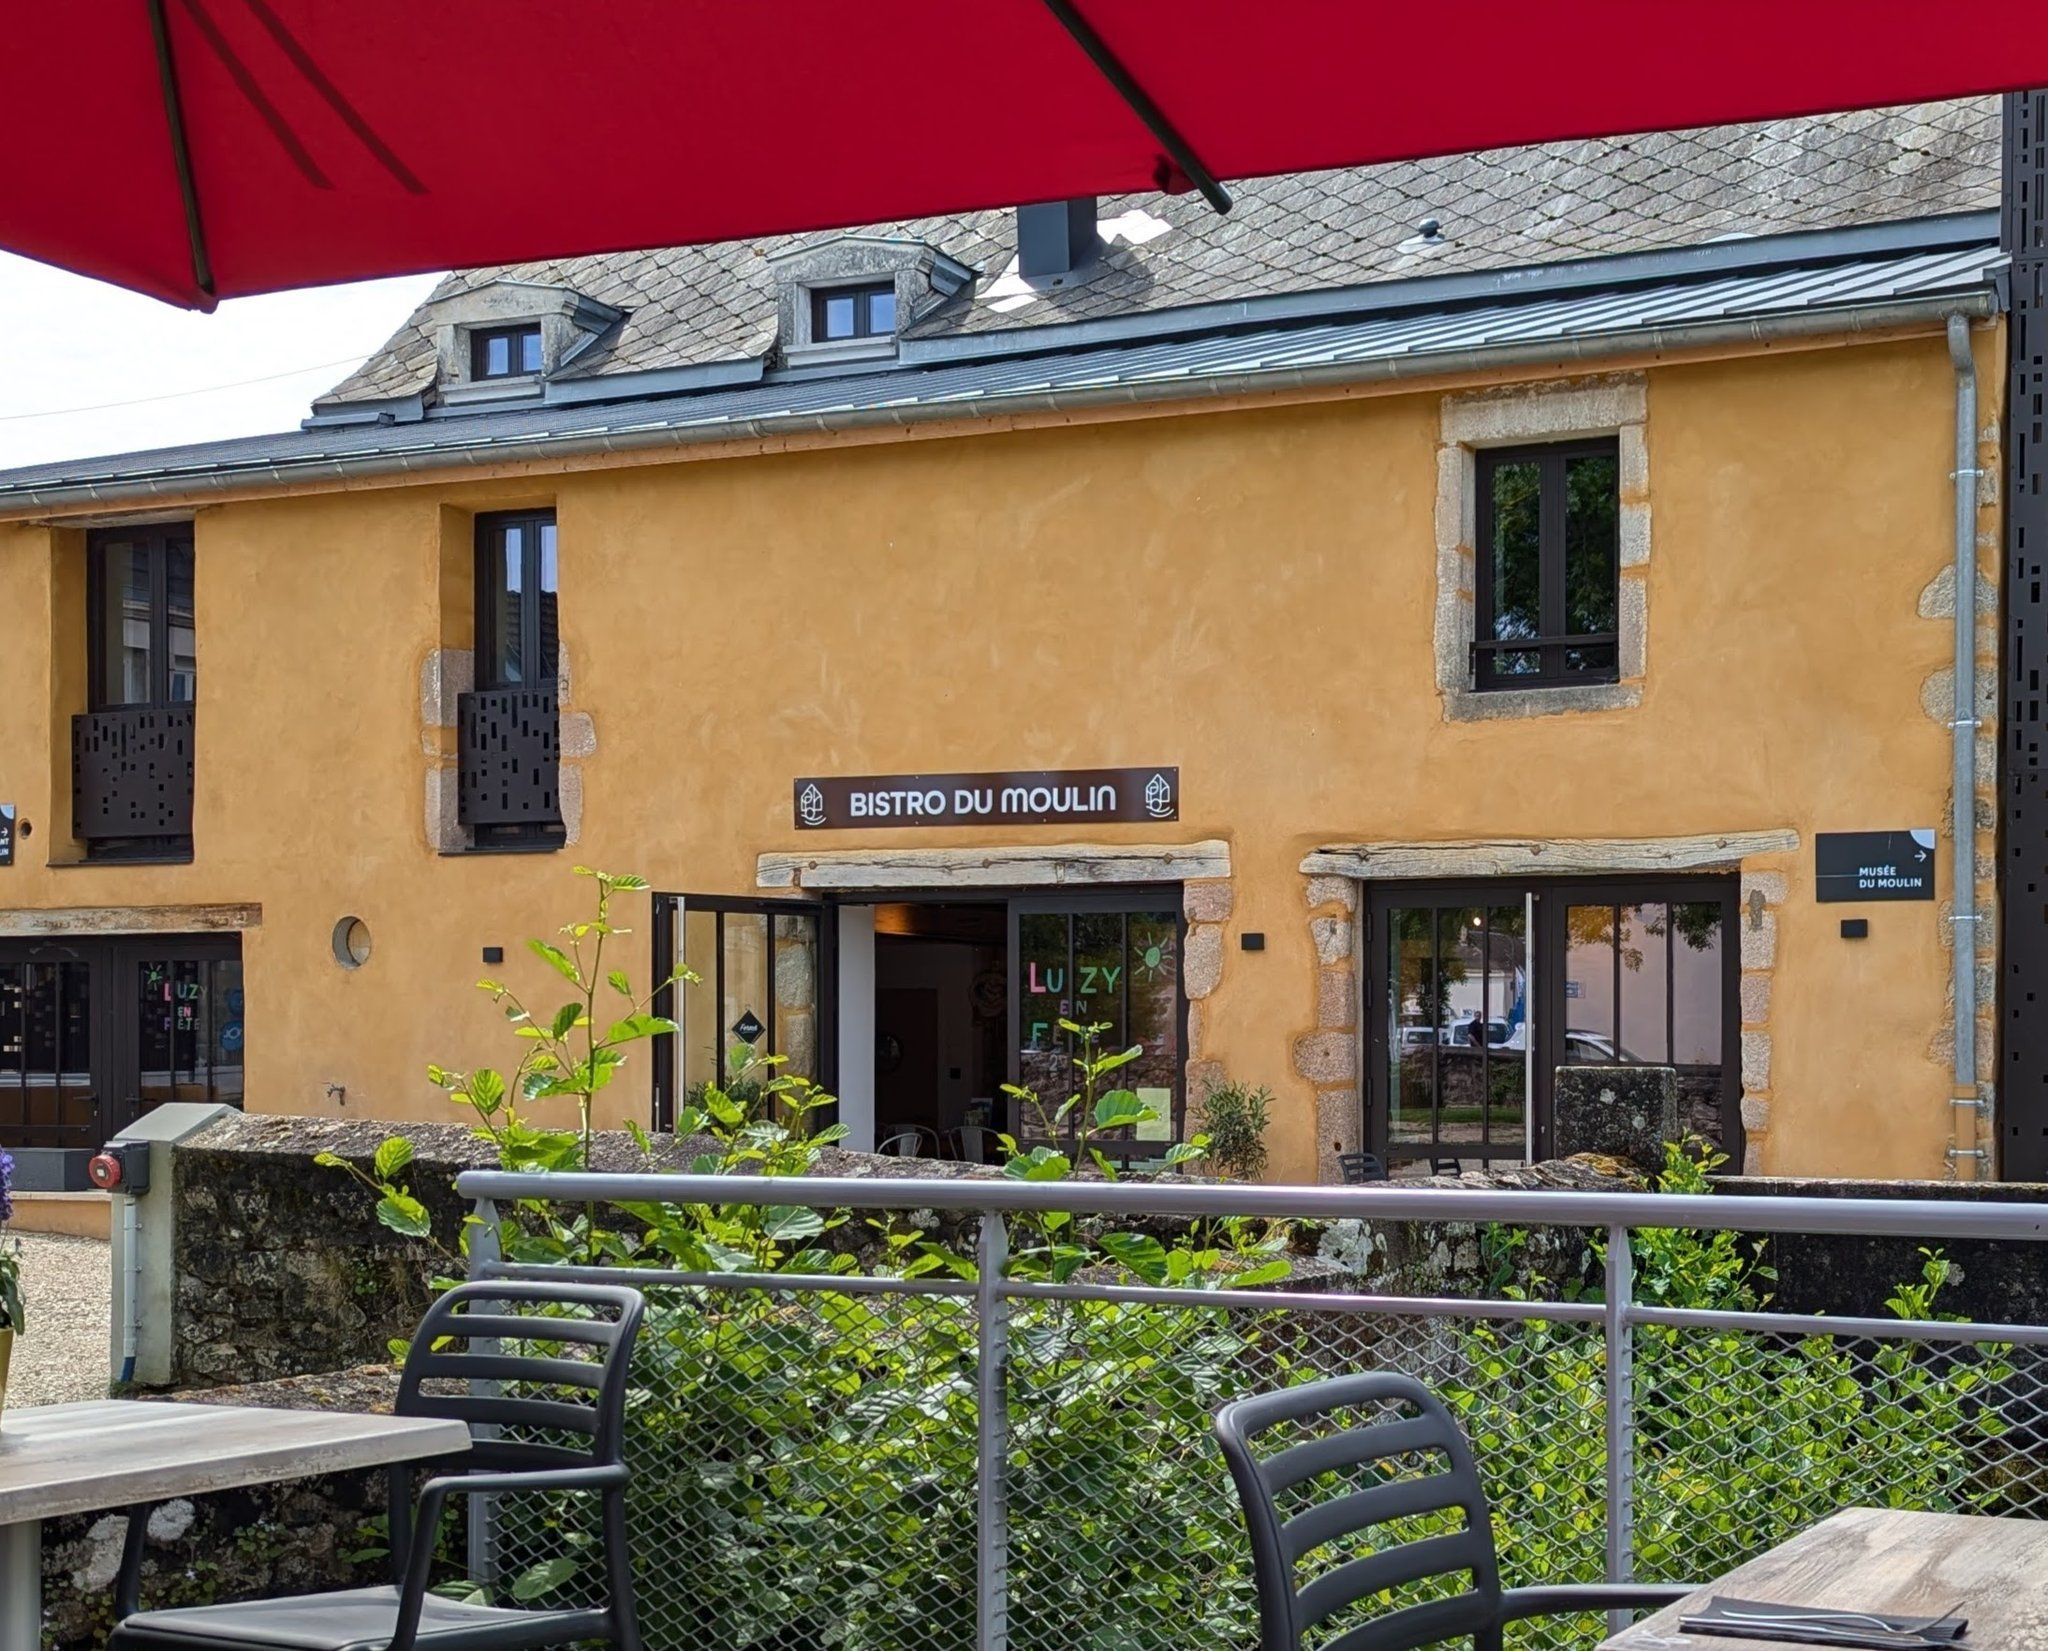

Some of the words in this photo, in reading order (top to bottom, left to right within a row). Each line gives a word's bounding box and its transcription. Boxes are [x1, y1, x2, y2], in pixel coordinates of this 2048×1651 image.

[850, 791, 946, 817] BISTRO
[954, 788, 993, 815] DU
[1001, 785, 1117, 813] MOULIN
[1859, 864, 1897, 877] MUSÉE
[1859, 879, 1876, 889] DU
[1878, 877, 1923, 888] MOULIN
[1030, 962, 1122, 994] LUZY
[1059, 1000, 1088, 1015] EN
